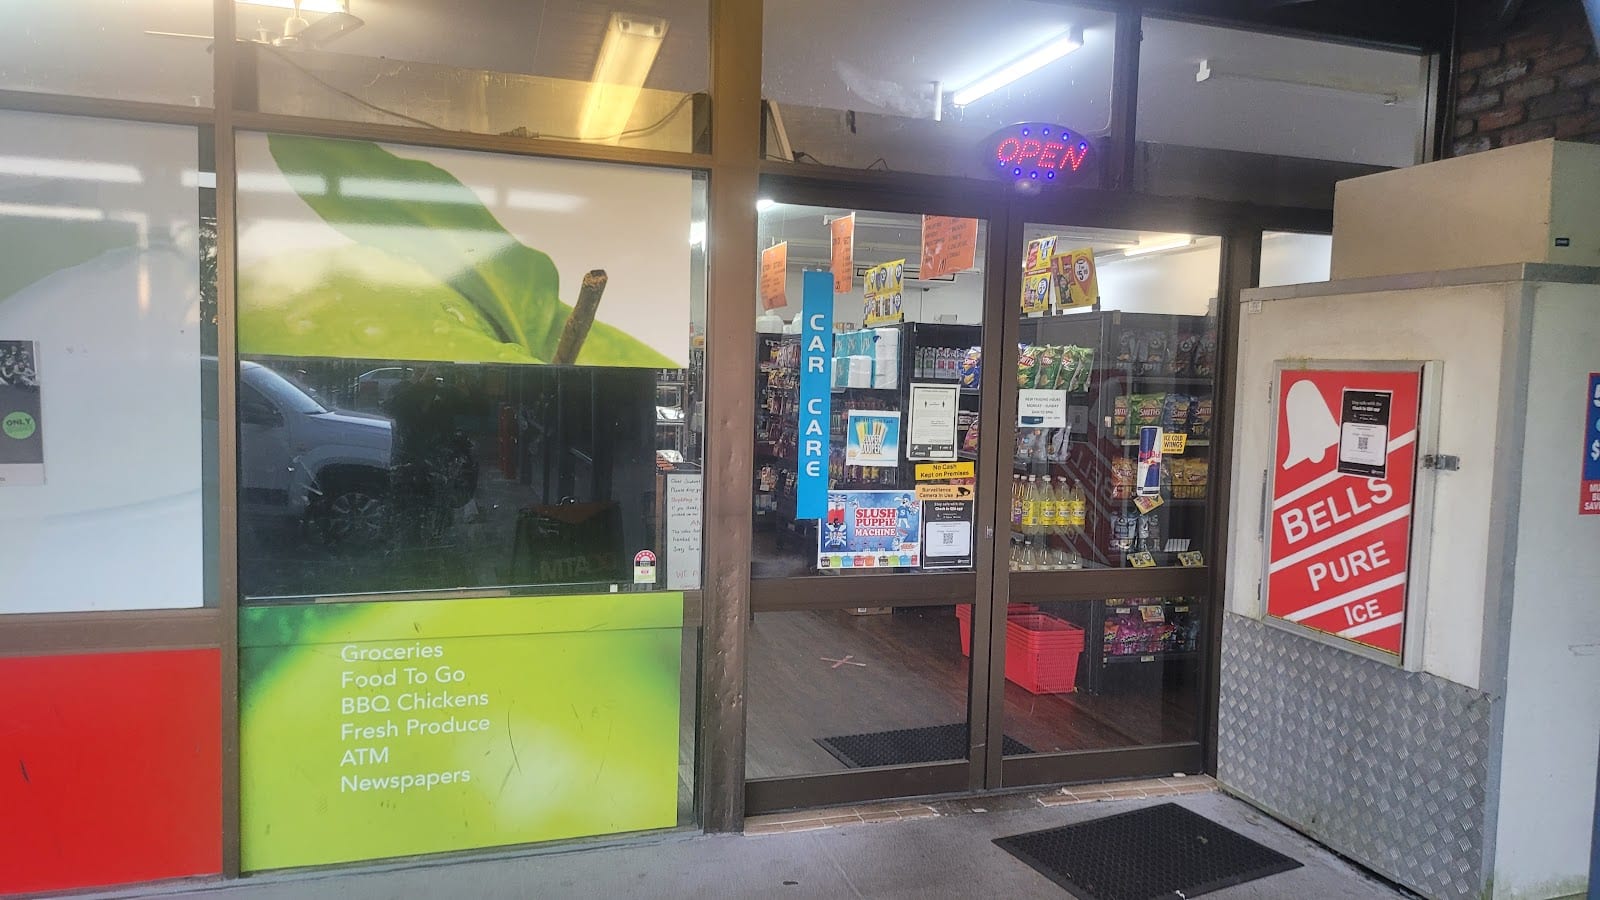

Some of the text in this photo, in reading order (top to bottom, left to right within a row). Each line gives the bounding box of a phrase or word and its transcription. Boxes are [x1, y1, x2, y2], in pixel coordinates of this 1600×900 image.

[998, 138, 1087, 171] OPEN
[807, 313, 826, 374] CAR
[6, 418, 31, 426] ONLY
[805, 398, 824, 477] CARE
[855, 508, 896, 519] SLUSH
[1280, 477, 1394, 545] BELLS
[855, 528, 896, 537] MACHINE
[1307, 540, 1391, 592] PURE
[1343, 599, 1383, 626] ICE
[341, 642, 444, 663] Groceries
[341, 666, 465, 689] Food To Go
[341, 691, 489, 715] BBQ Chickens
[341, 716, 490, 741] Fresh Produce
[340, 747, 389, 767] ATM
[341, 770, 471, 794] Newspapers
